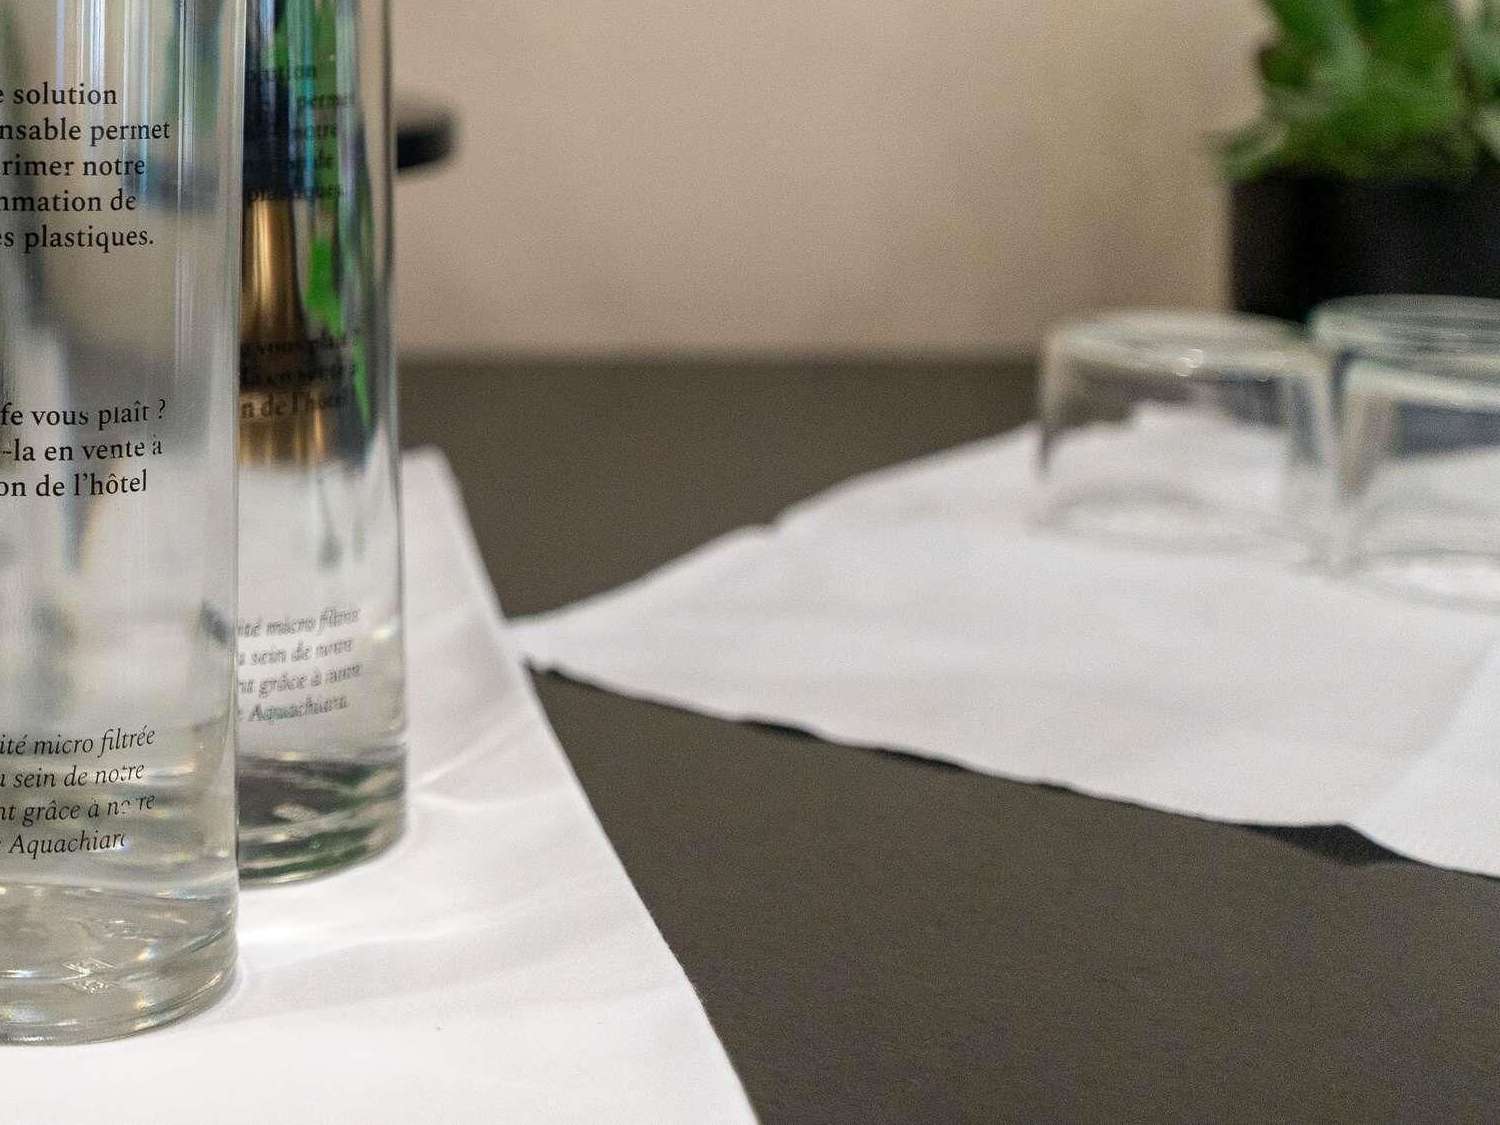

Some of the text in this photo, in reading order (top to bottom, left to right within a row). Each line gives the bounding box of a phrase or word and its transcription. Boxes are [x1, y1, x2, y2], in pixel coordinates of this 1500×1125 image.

[12, 81, 118, 106] solution
[89, 120, 171, 147] permet
[82, 156, 147, 176] notre
[109, 188, 137, 212] de
[22, 224, 155, 254] plastiques.
[31, 408, 89, 426] vous
[44, 444, 74, 462] en
[80, 439, 146, 461] vente
[34, 473, 66, 497] de
[33, 734, 94, 755] micro
[96, 724, 156, 758] filtrée
[12, 768, 57, 788] sein
[63, 764, 88, 787] de
[21, 801, 80, 827] grâce
[87, 797, 100, 819] à
